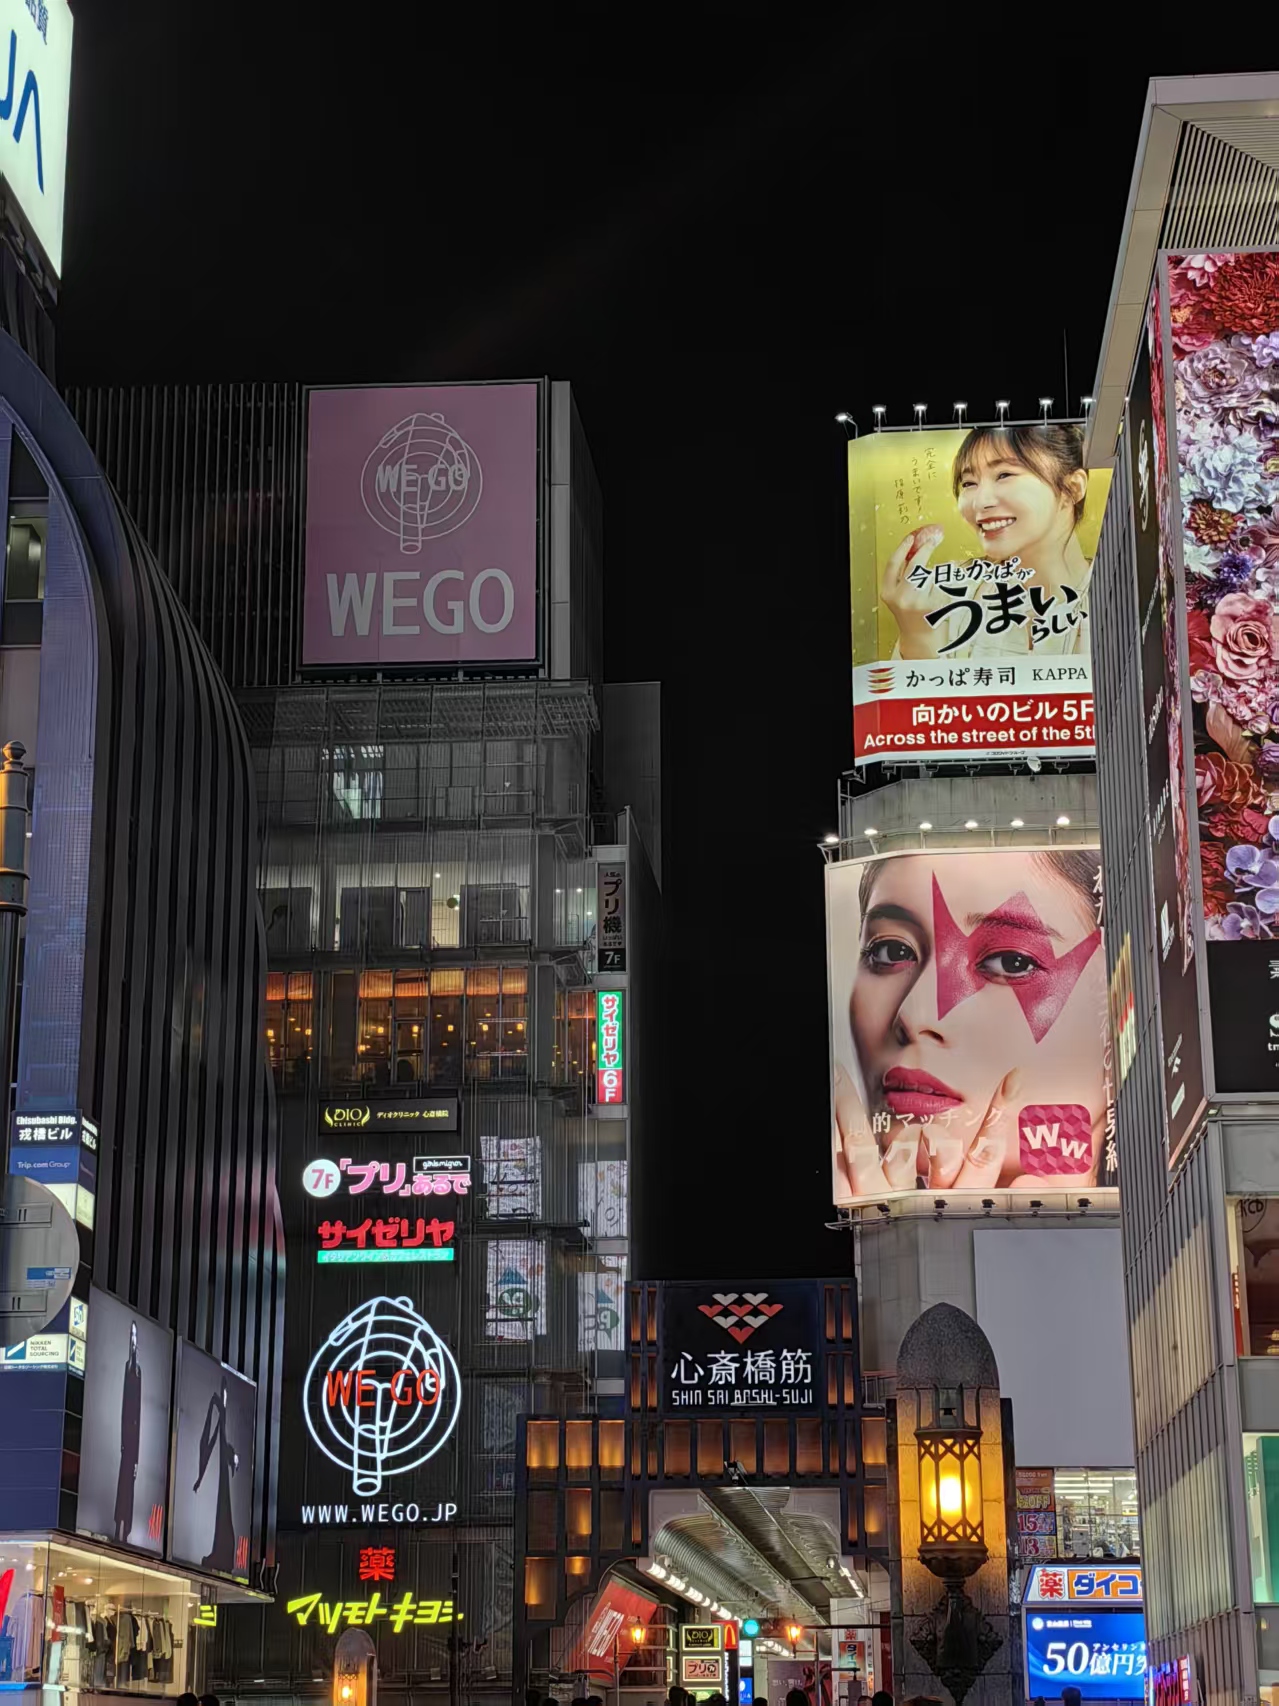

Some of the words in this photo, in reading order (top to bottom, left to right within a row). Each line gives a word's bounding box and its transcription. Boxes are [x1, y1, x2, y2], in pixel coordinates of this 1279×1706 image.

[906, 557, 1034, 589] 今日もかっぱが
[327, 568, 515, 637] WEGO
[906, 666, 1016, 688] かっぱ寿司
[1032, 667, 1088, 682] KAPPA
[864, 730, 925, 749] Across
[930, 729, 958, 746] the
[962, 727, 1015, 744] street
[1019, 726, 1038, 742] of
[1042, 724, 1071, 741] the
[603, 878, 623, 934] プリ機
[604, 951, 621, 965] 7F
[602, 995, 619, 1067] サイゼリヤ
[603, 1069, 618, 1101] 6F
[333, 1108, 363, 1121] DIO
[18, 1127, 73, 1141] 戎橋ビル
[17, 1161, 49, 1169] Trip.com
[311, 1169, 334, 1189] 7F
[317, 1217, 455, 1249] サイゼリヤ
[670, 1348, 813, 1386] 心斎橋筋
[671, 1390, 702, 1406] SHIN
[301, 1503, 458, 1523] WWW.WEGO.JP
[359, 1547, 395, 1581] 薬
[1038, 1568, 1066, 1600] 薬
[287, 1592, 464, 1634] マツモトキヨシ
